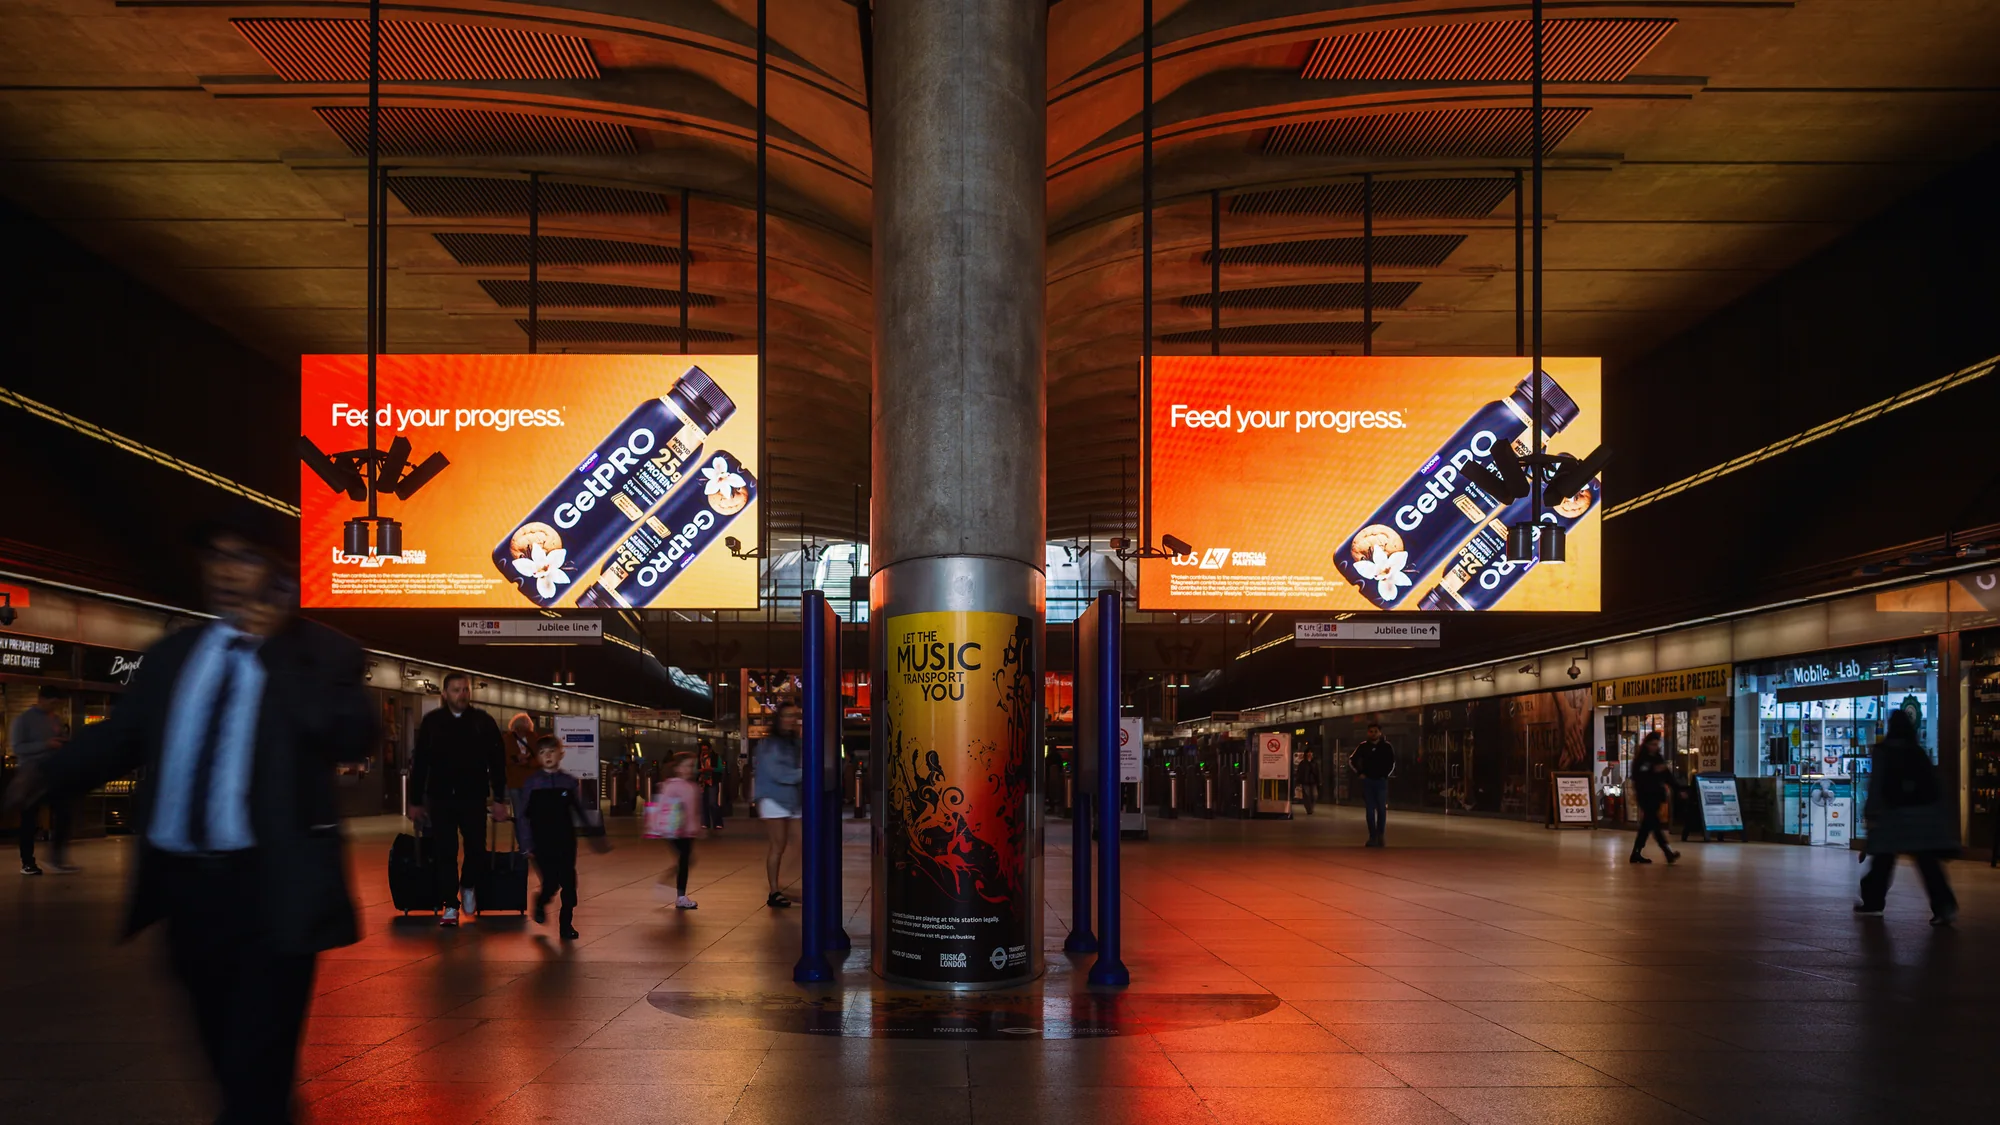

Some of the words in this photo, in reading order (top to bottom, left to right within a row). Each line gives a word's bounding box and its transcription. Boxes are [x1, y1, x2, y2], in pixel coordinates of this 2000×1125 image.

[332, 403, 391, 426] Feed
[396, 408, 450, 431] your
[1171, 404, 1230, 428] Feed
[1236, 409, 1289, 433] your
[671, 444, 684, 456] RECIPE
[672, 437, 691, 455] IMPROVED
[1514, 446, 1525, 457] RECIP
[579, 452, 599, 473] DANONE
[650, 448, 683, 483] 25g
[1421, 454, 1441, 475] DANONE
[554, 428, 655, 529] GetPRO
[638, 475, 655, 492] VITAMIN
[641, 471, 666, 494] MAGNESIUM
[643, 460, 674, 490] PROTEIN
[1395, 430, 1497, 531] GetPRO
[623, 539, 646, 562] PROTEIN
[637, 509, 715, 587] GetPRO
[1231, 551, 1267, 559] OFFICIAL
[1465, 542, 1489, 565] PROTEIN
[616, 545, 641, 572] 25g
[680, 552, 696, 569] DANONE
[1231, 558, 1267, 566] PARTNER
[1459, 547, 1483, 575] 25g
[537, 623, 570, 632] Jubilee
[573, 623, 590, 632] line
[903, 632, 915, 644] LET
[918, 630, 937, 642] THE
[1374, 626, 1408, 635] Jubilee
[1410, 626, 1428, 635] line
[35, 643, 54, 655] BAGELS
[897, 642, 981, 673] MUSIC
[2, 653, 21, 665] GREAT
[21, 655, 41, 668] COFFEE
[903, 671, 965, 684] TRANSPORT
[1793, 664, 1829, 684] Mobile
[1839, 659, 1860, 678] Lab
[921, 683, 965, 701] YOU
[1622, 678, 1650, 698] ARTISAN
[1651, 675, 1678, 695] COFFEE
[1679, 674, 1685, 691] &
[1686, 669, 1726, 691] PRETZELS
[922, 915, 940, 923] playing
[940, 953, 958, 961] BUSK
[940, 960, 967, 968] LONDON
